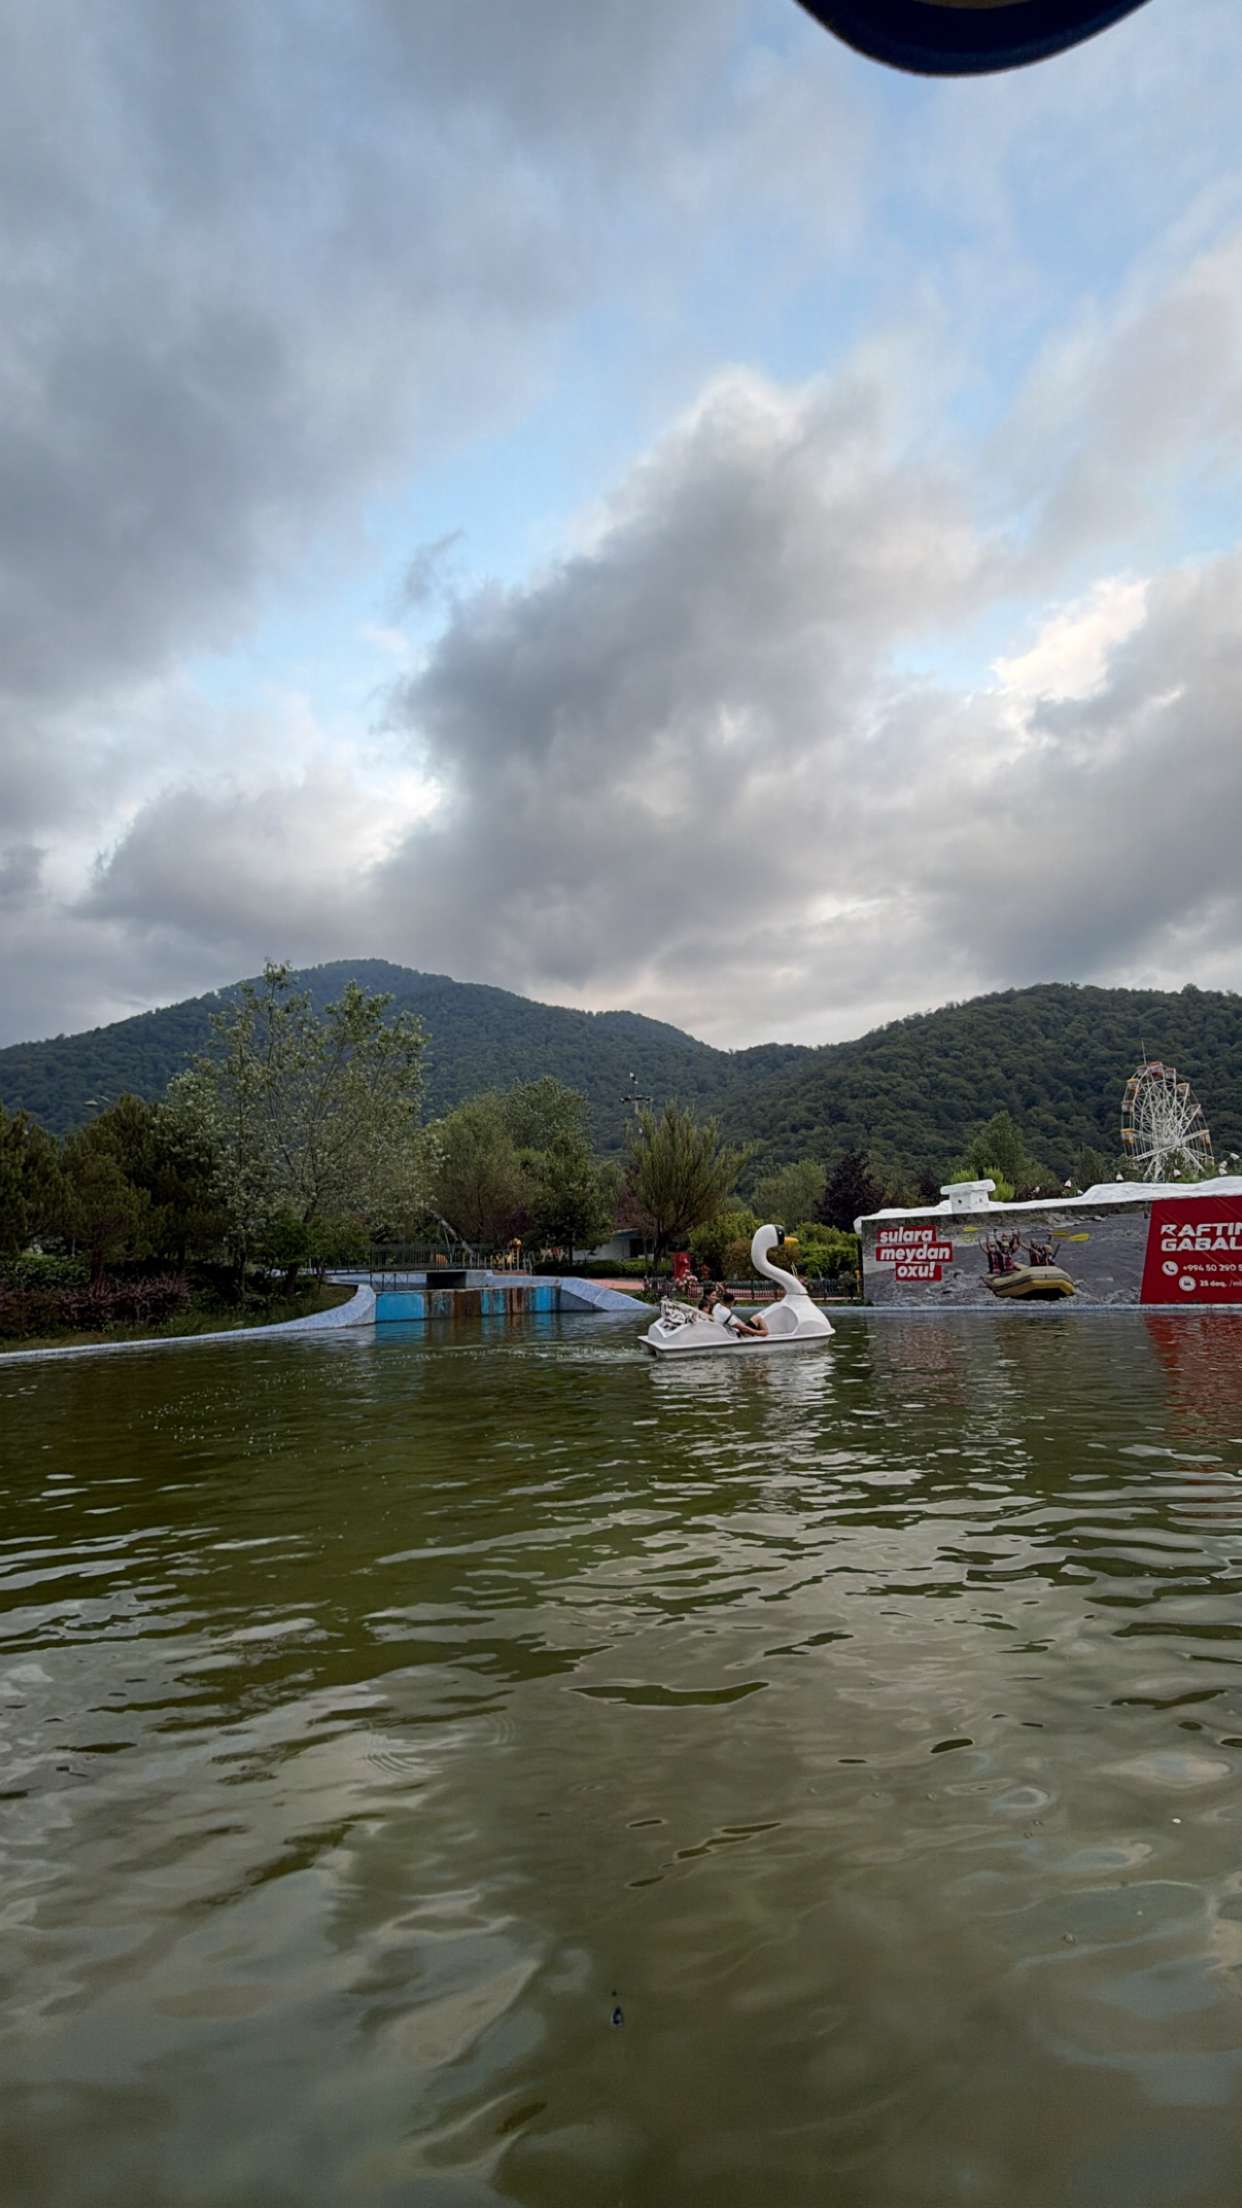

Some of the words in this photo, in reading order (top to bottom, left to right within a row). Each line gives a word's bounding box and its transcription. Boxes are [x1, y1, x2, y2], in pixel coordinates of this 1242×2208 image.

[880, 1227, 933, 1243] sulara
[880, 1244, 950, 1263] meydan
[898, 1262, 936, 1277] oxu!
